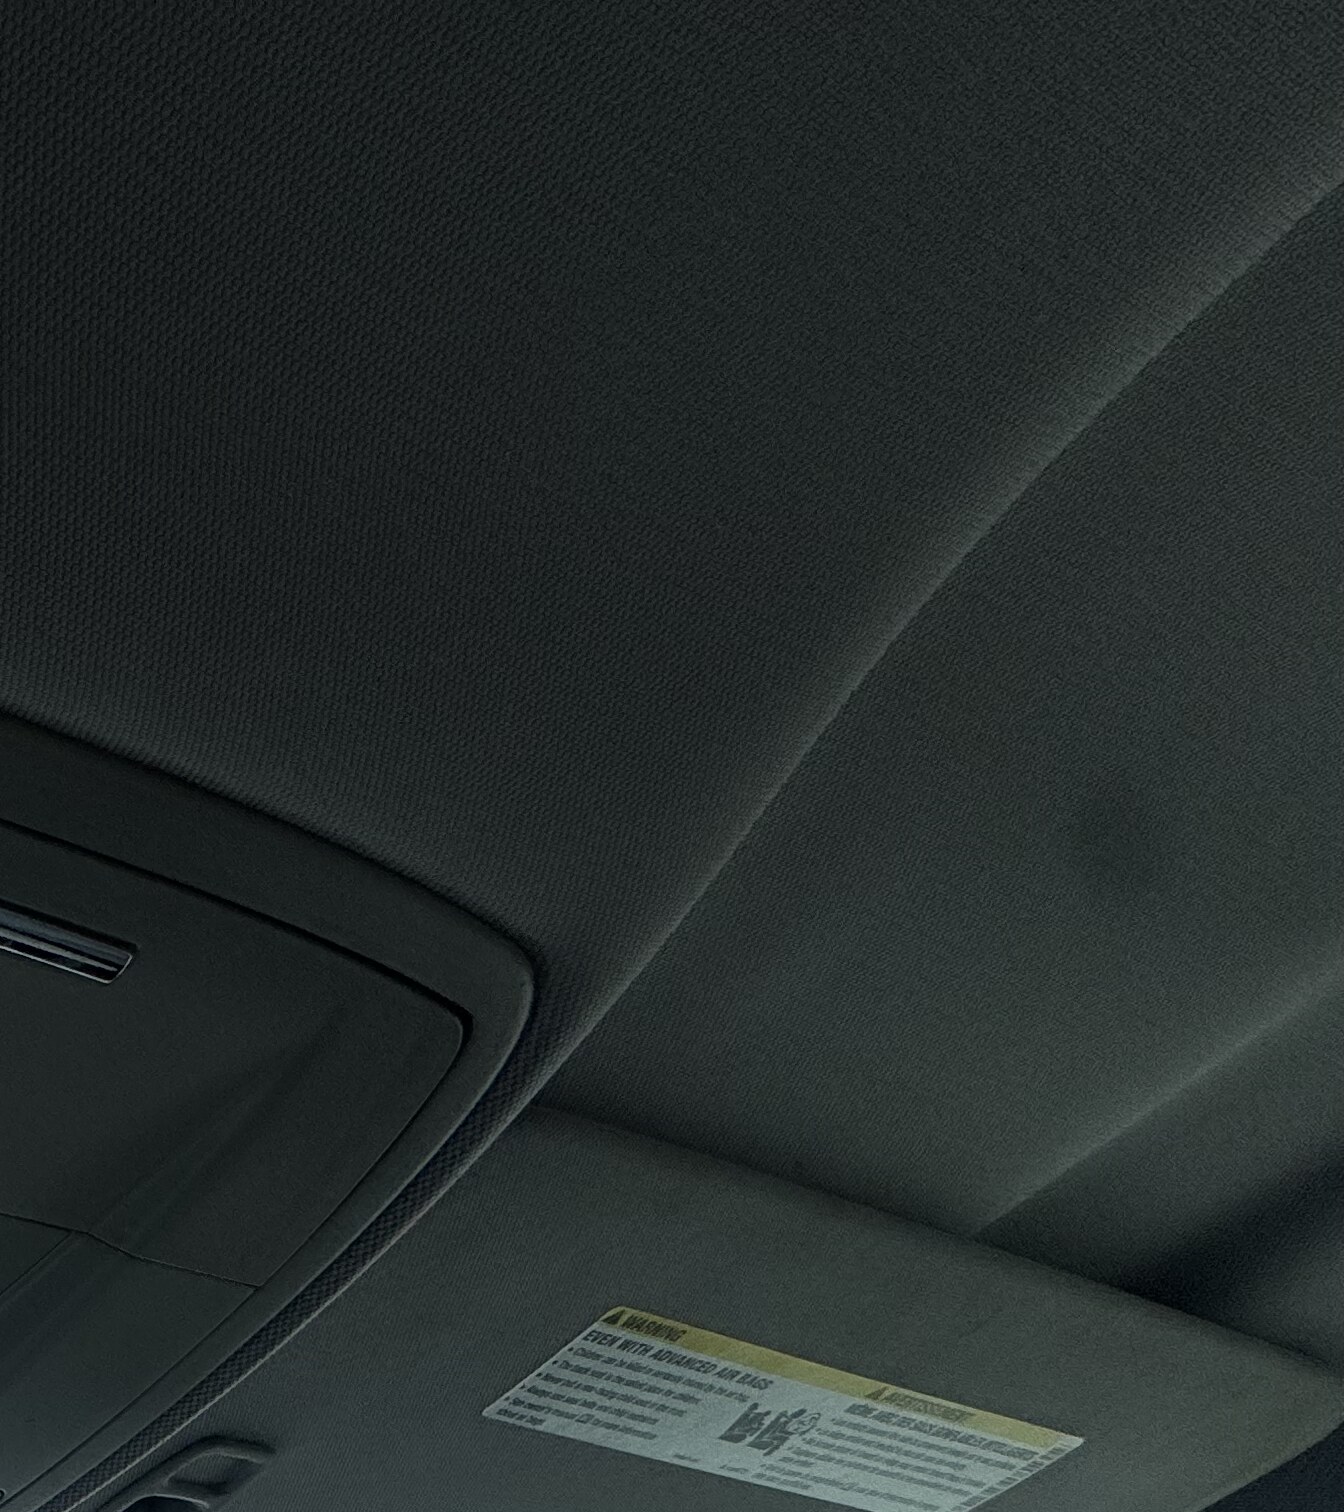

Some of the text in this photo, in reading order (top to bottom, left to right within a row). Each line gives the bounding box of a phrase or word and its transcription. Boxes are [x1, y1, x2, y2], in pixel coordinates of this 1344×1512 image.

[620, 1314, 687, 1343] WARNING
[582, 1329, 622, 1348] EVEN
[616, 1338, 654, 1357] WITH
